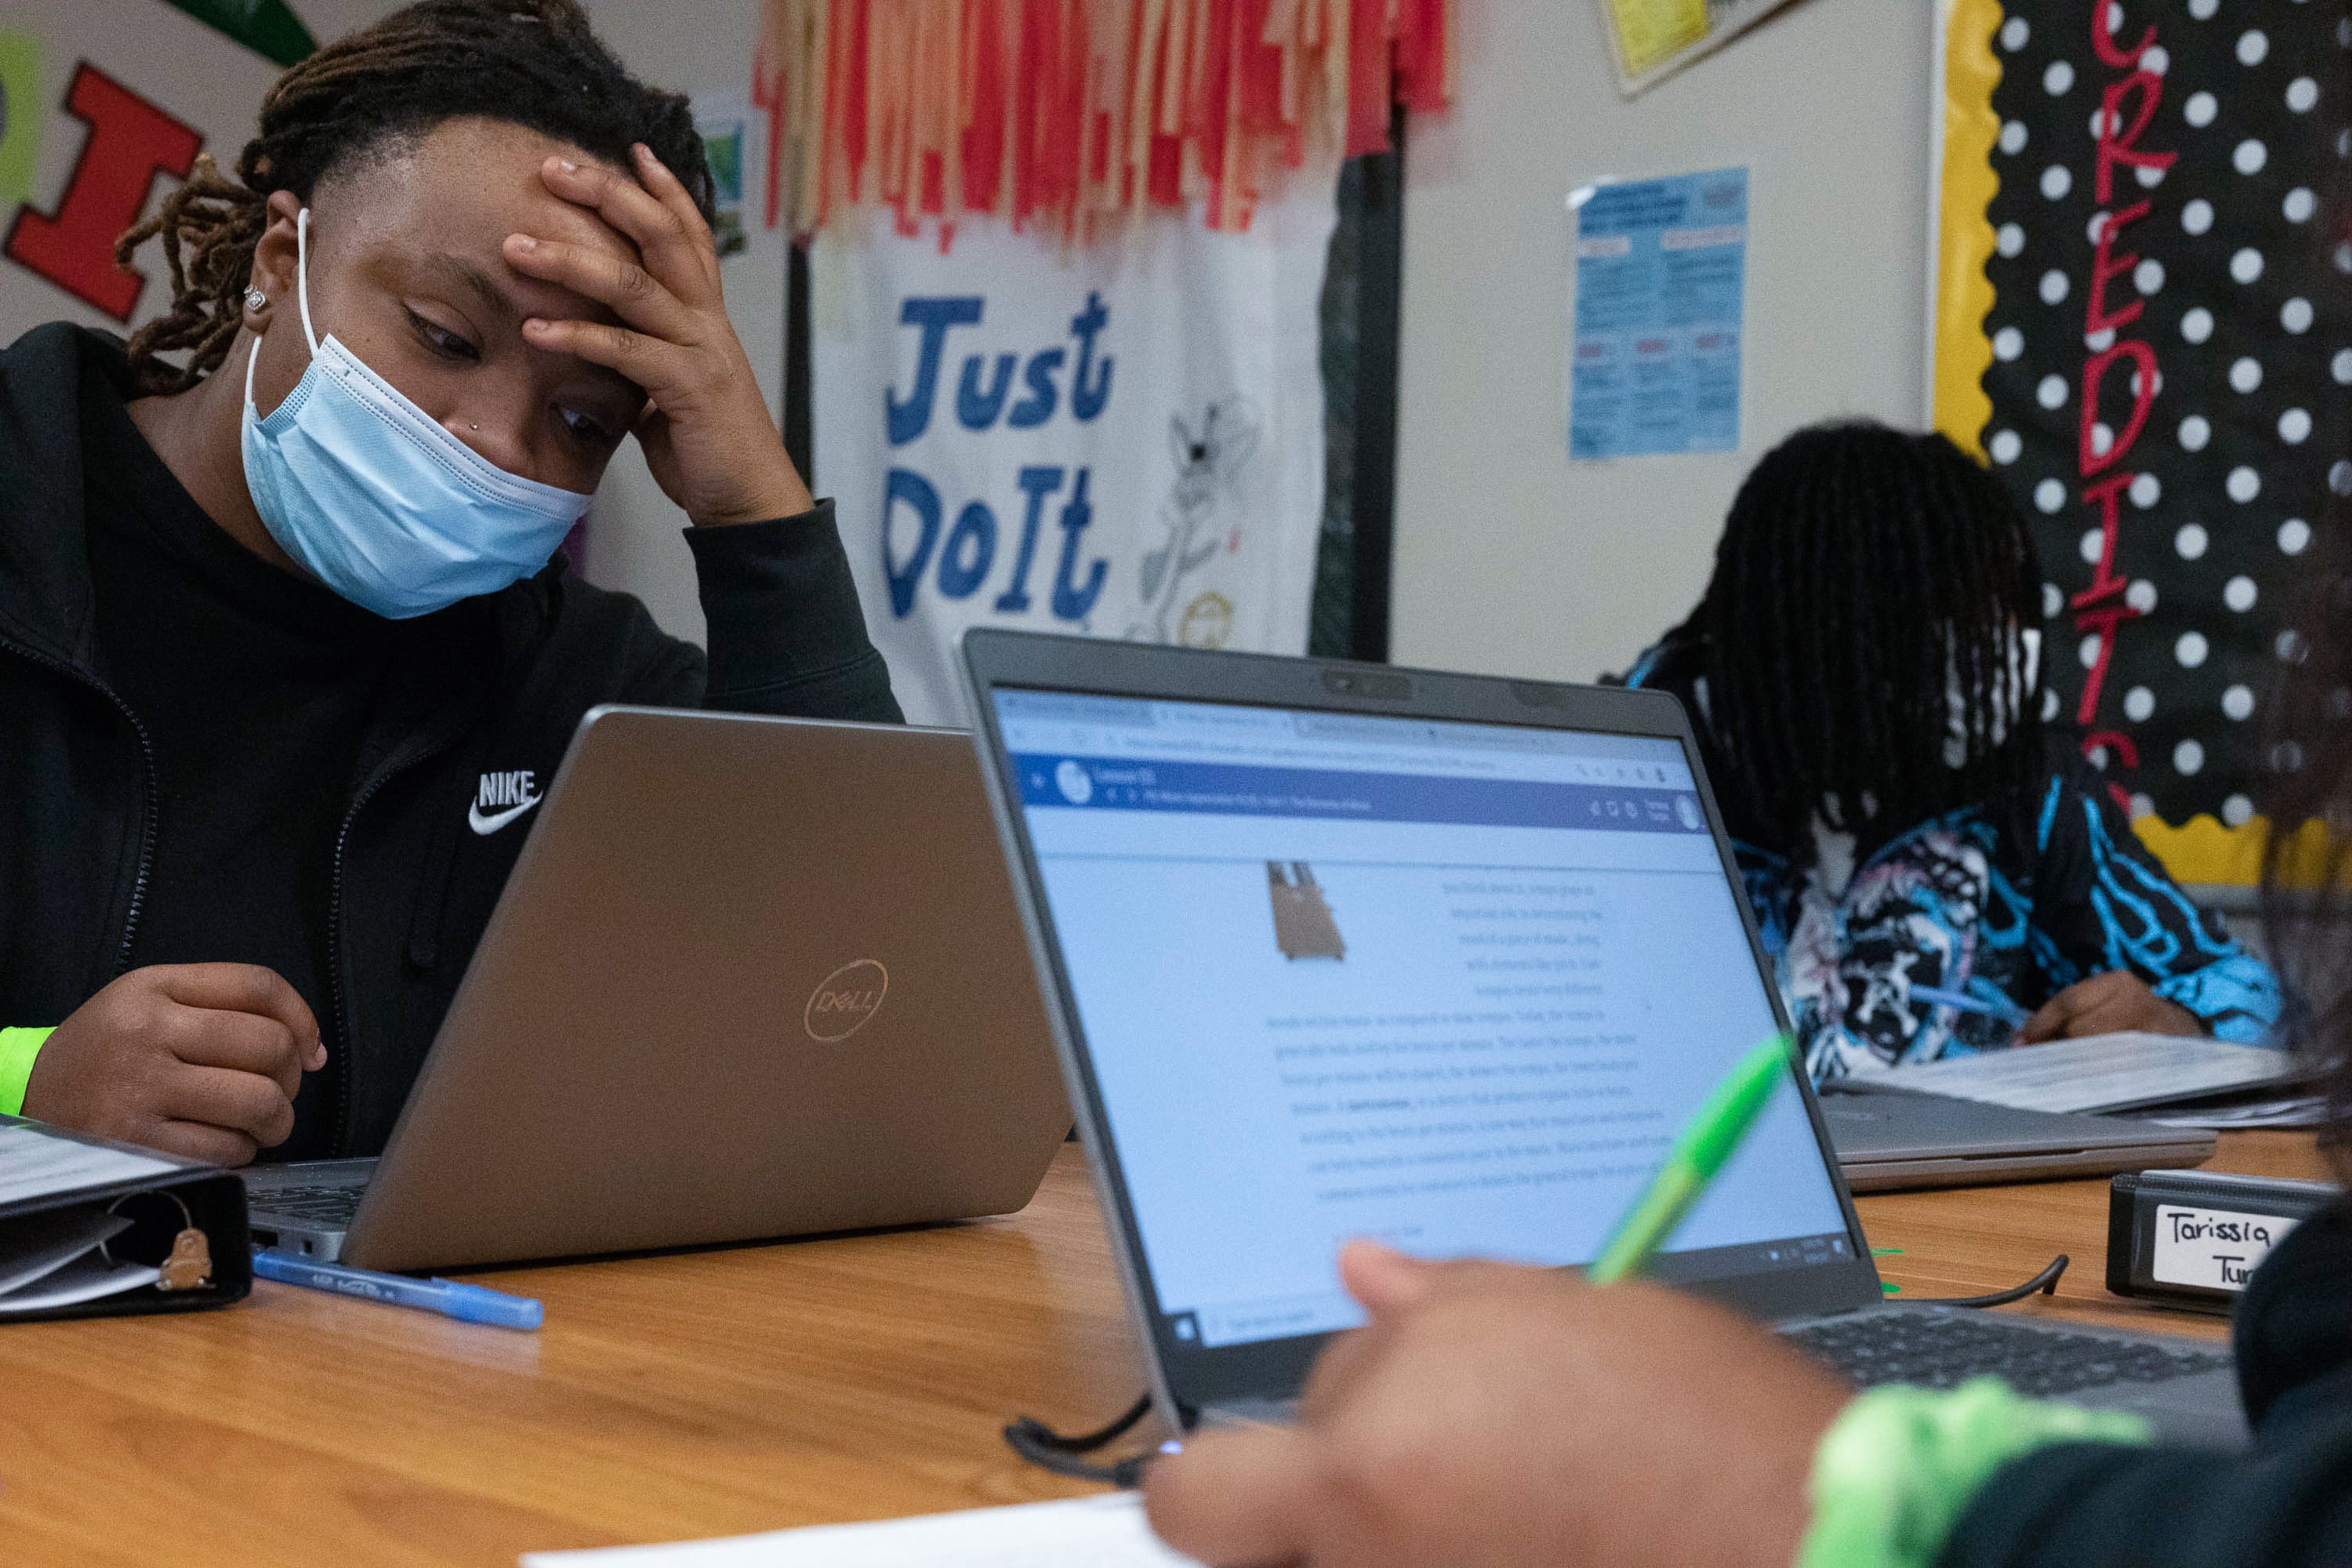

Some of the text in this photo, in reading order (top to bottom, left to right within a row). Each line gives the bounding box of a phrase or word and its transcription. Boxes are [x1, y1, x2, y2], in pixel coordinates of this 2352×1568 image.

[886, 290, 1115, 448] Just
[479, 770, 535, 808] NIKE
[2167, 1212, 2272, 1247] Tarissia
